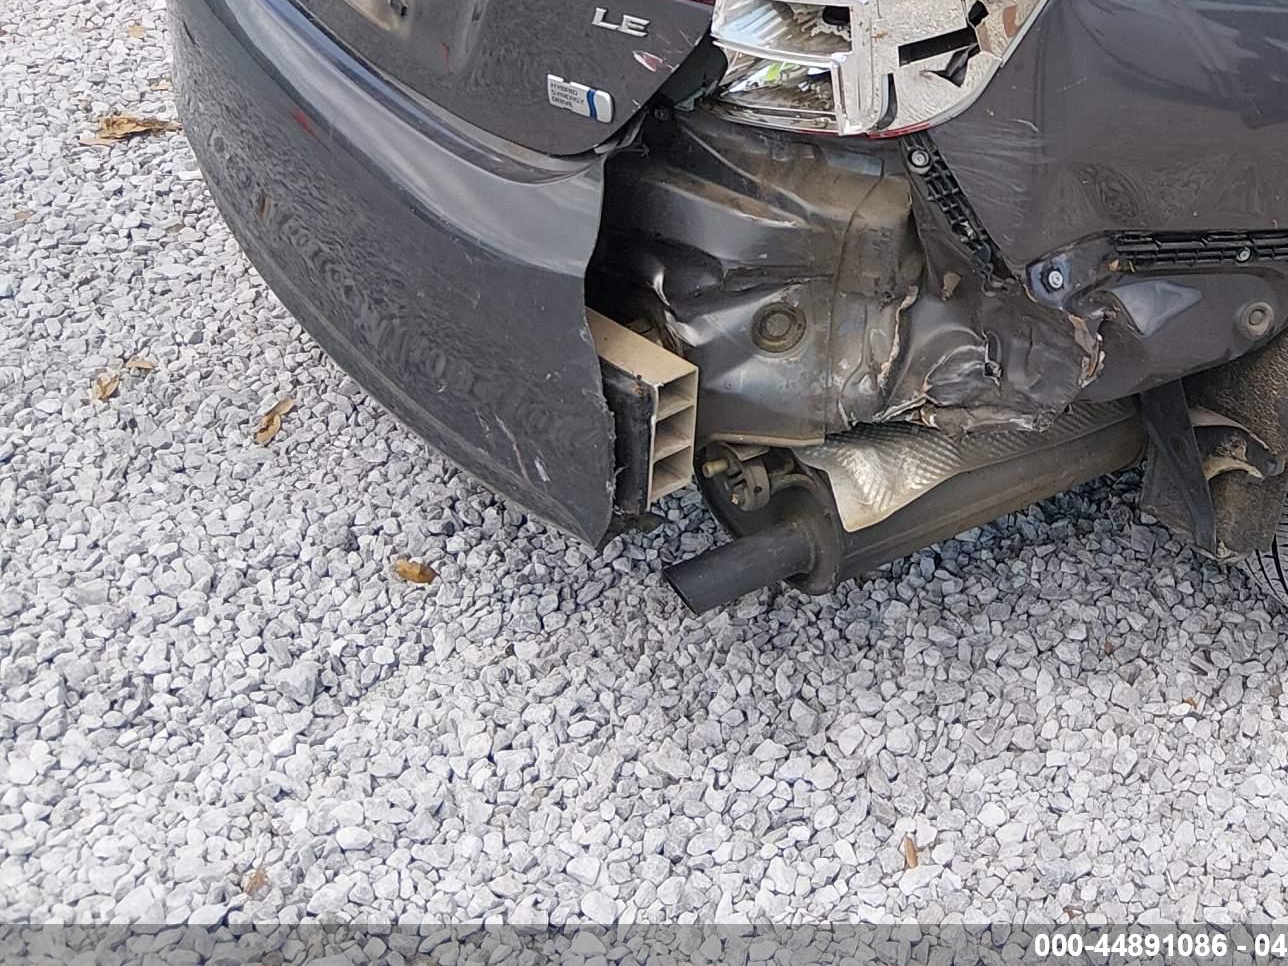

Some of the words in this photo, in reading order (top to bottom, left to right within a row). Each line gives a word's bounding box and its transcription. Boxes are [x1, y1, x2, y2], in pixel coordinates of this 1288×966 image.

[591, 7, 651, 38] LE
[550, 82, 578, 96] HYBRID
[551, 89, 585, 106] SYNERGY
[551, 96, 575, 108] DRIVE
